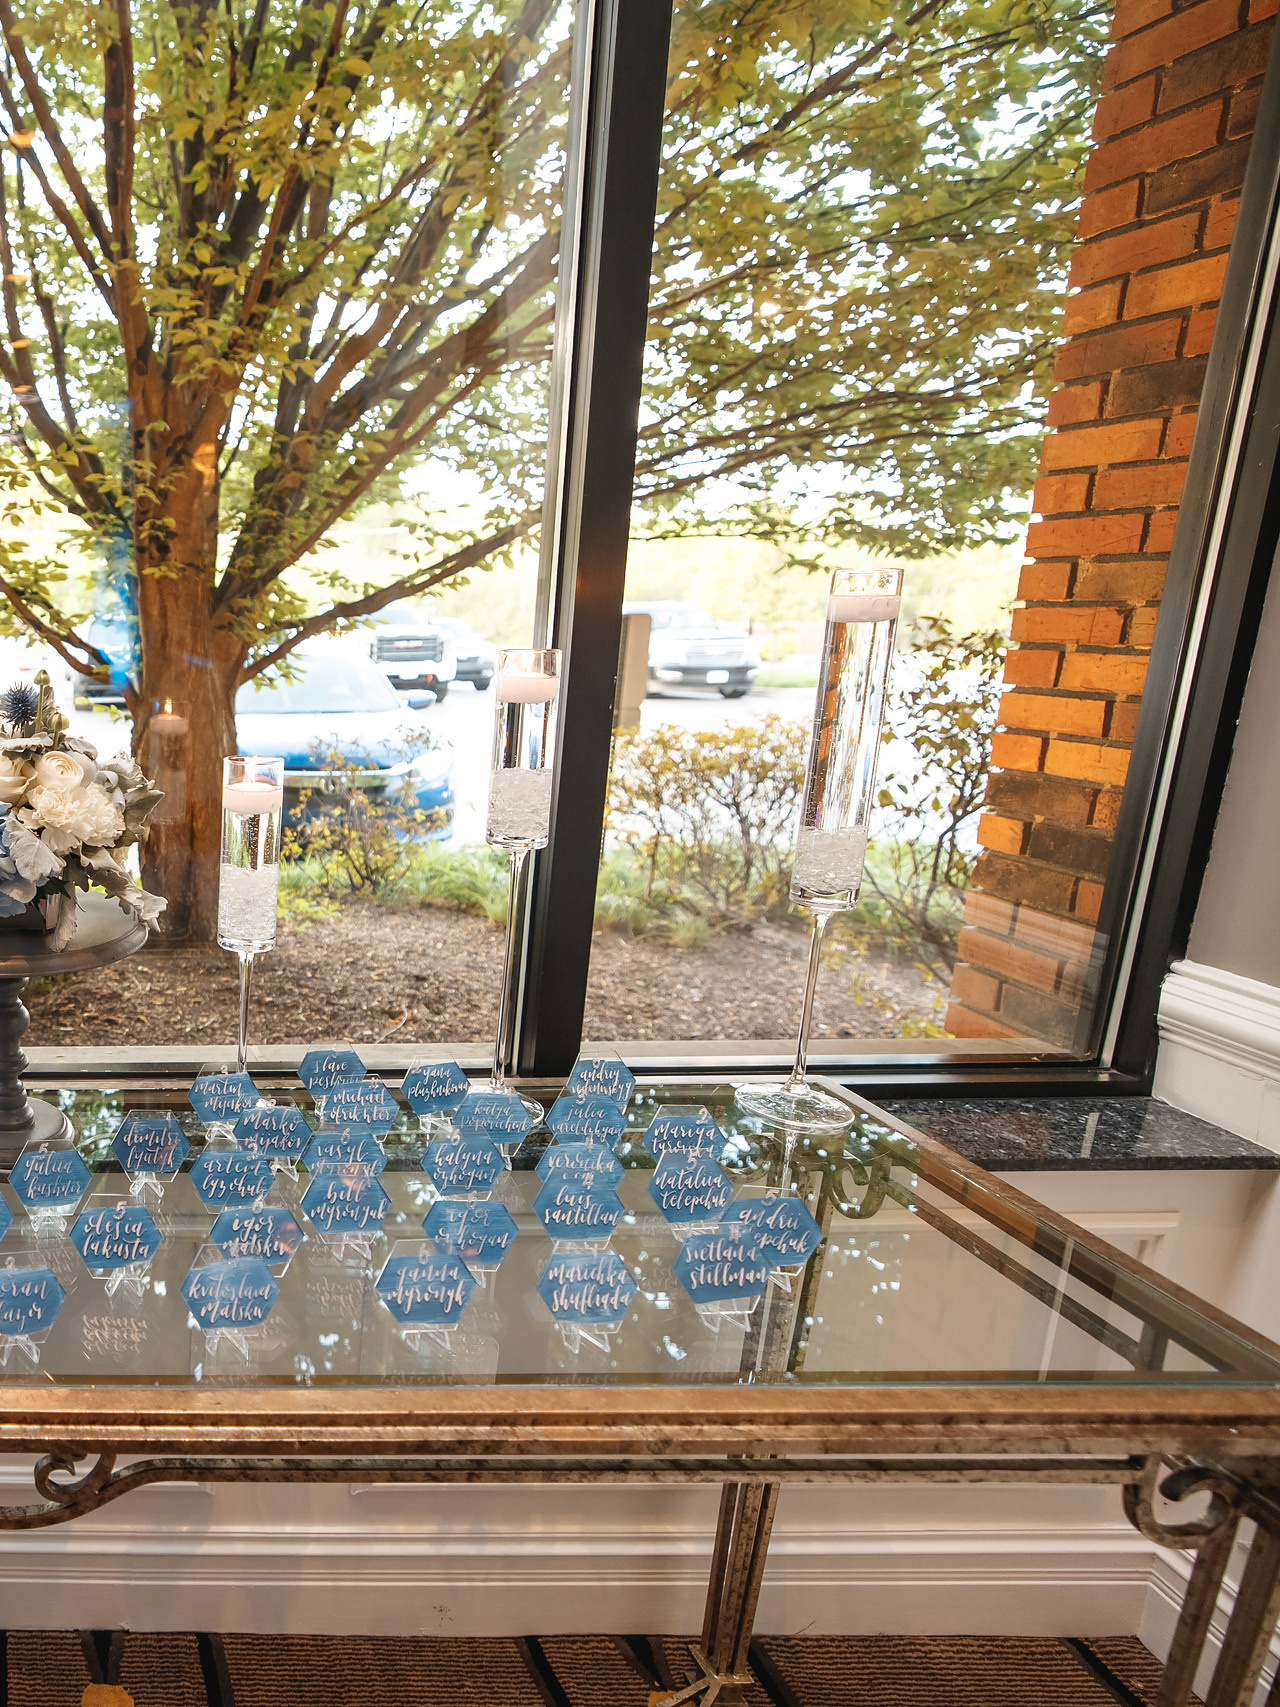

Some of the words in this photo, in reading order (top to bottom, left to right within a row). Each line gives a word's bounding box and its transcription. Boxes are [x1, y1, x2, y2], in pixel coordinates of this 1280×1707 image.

[422, 1066, 452, 1085] yana
[554, 1185, 592, 1209] luis
[113, 1201, 127, 1220] 5
[419, 1242, 430, 1265] 6
